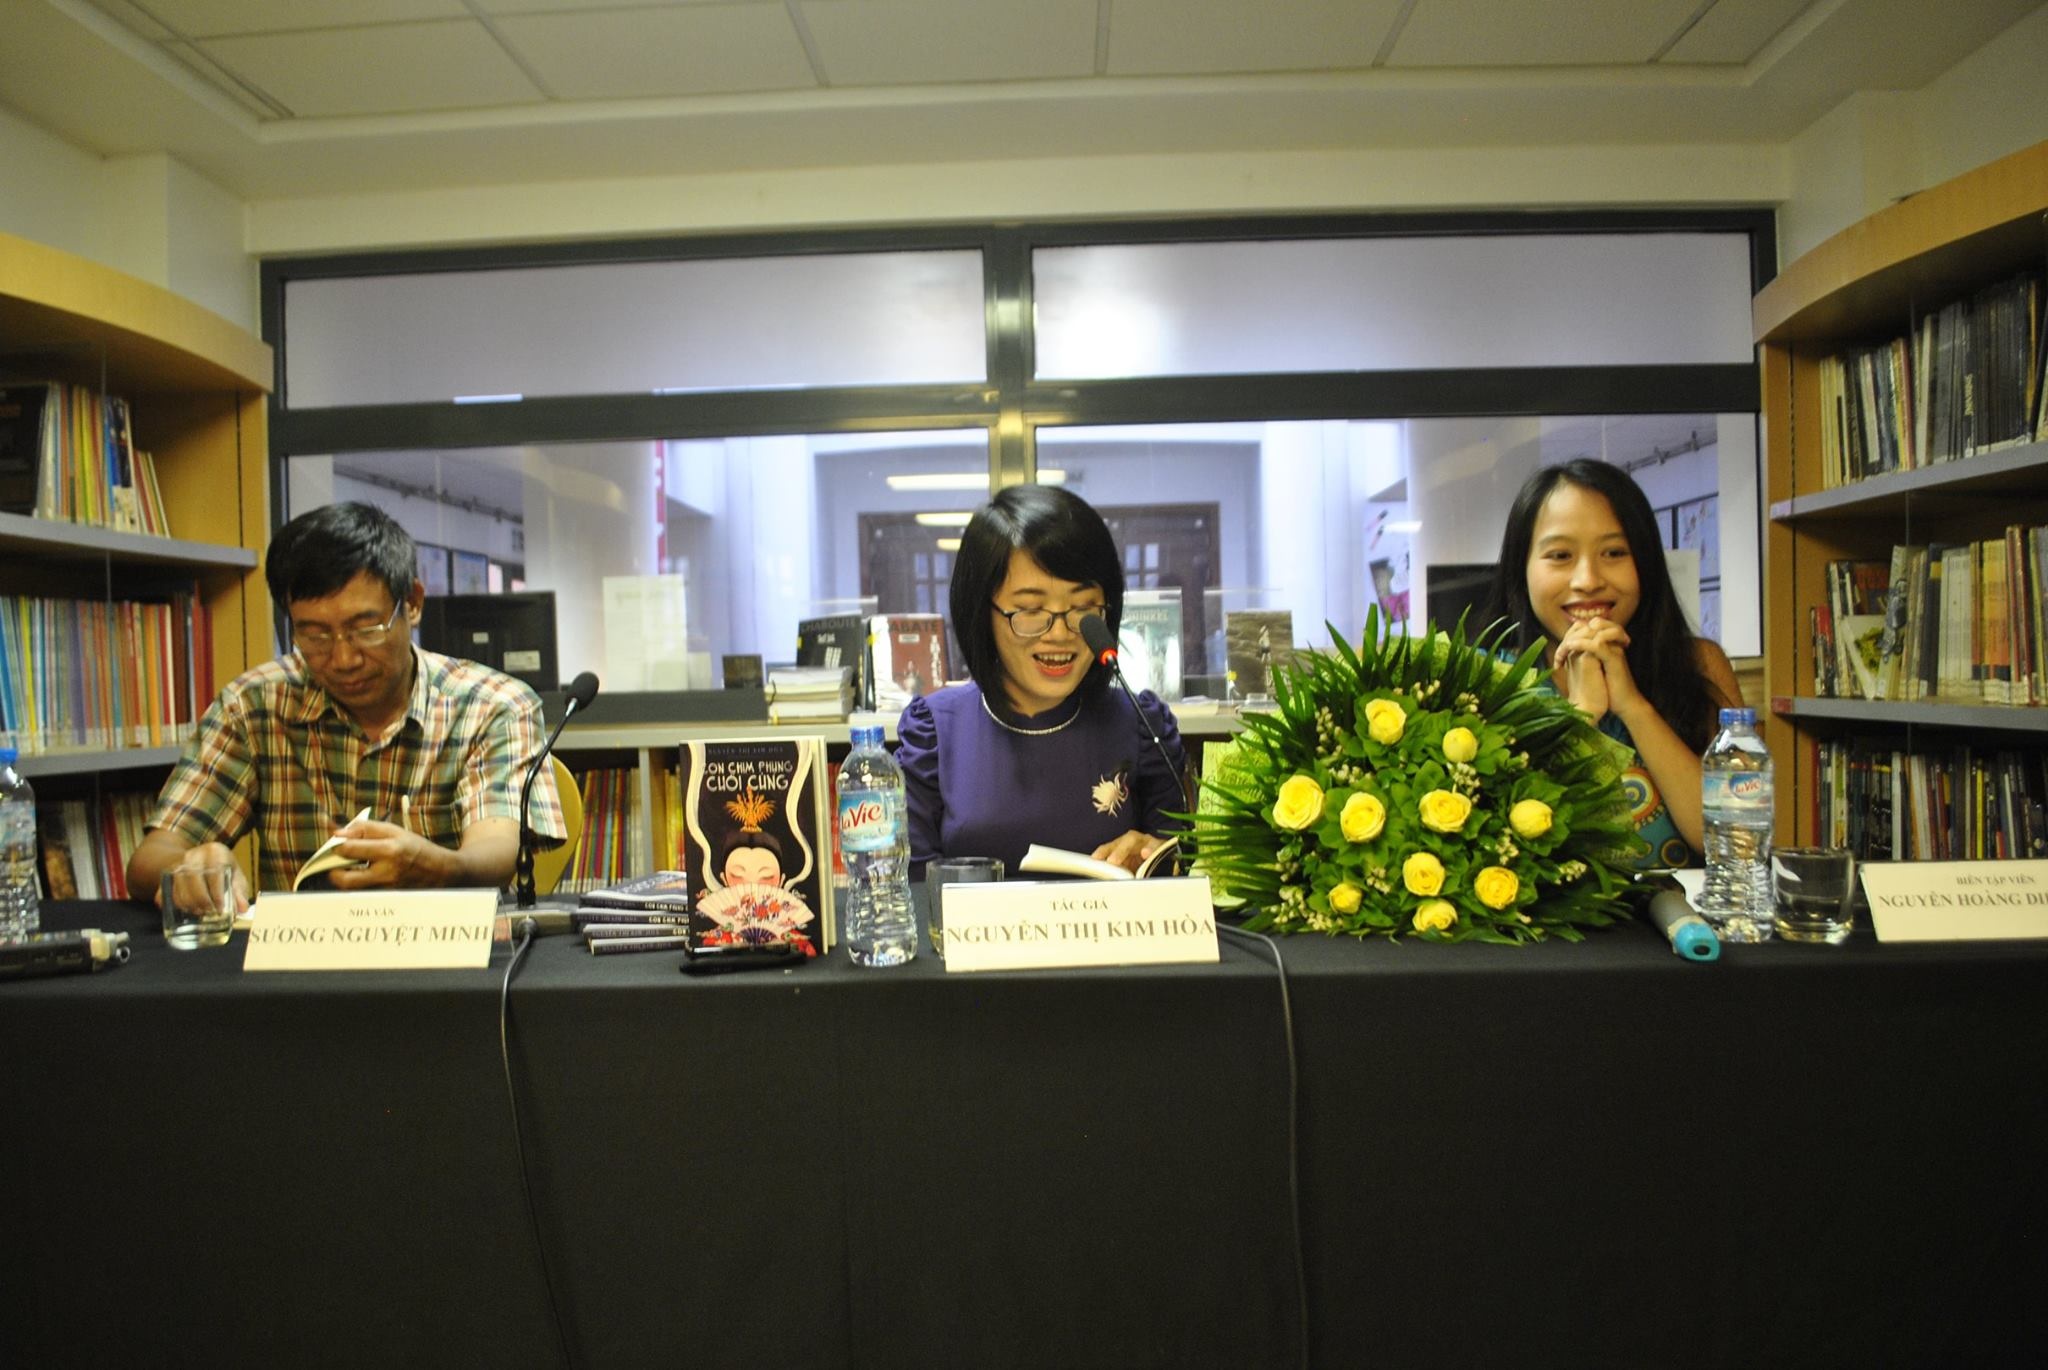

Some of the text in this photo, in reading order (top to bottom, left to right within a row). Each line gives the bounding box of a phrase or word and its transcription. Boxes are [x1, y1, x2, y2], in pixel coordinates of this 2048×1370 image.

[703, 762, 725, 775] ON
[728, 761, 755, 774] CHIM
[2008, 873, 2036, 885] VIÊN
[1049, 898, 1079, 912] TÁC
[1957, 889, 2023, 907] HOÀNG
[251, 923, 489, 947] SƯƠNG NGUYỆT MINH
[1055, 921, 1099, 943] THỊ
[1107, 919, 1155, 938] KIM
[1163, 913, 1214, 937] HÒA
